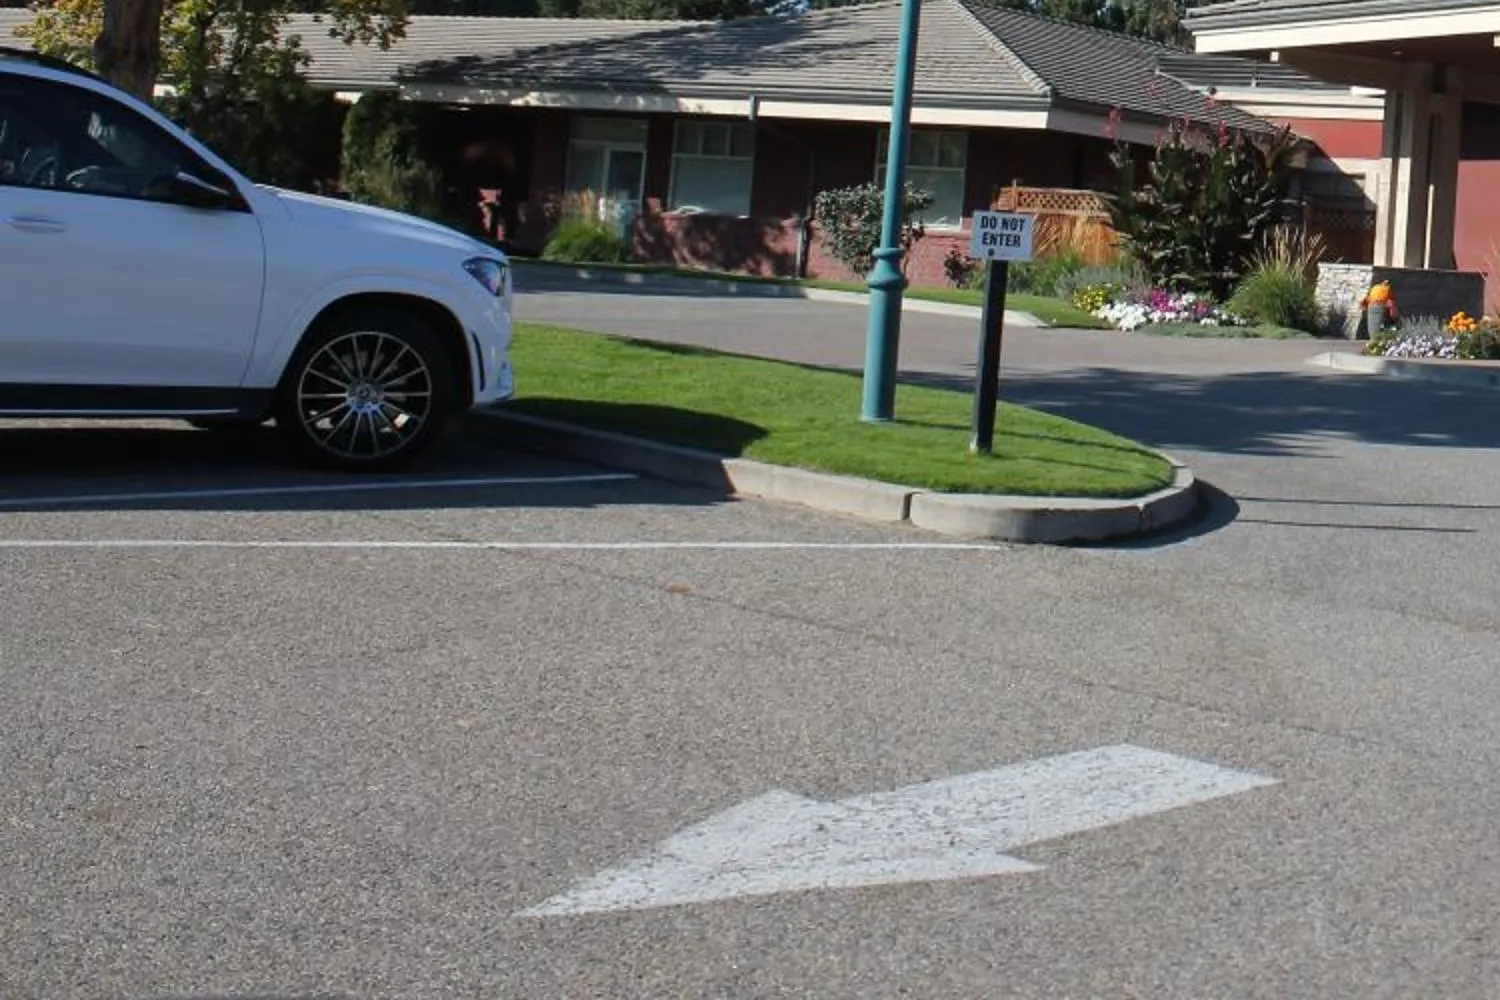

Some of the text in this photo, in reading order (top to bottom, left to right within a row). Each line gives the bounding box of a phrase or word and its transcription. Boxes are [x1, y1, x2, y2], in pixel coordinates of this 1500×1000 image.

[981, 215, 1025, 232] DO NOT
[981, 232, 1021, 248] ENTER
